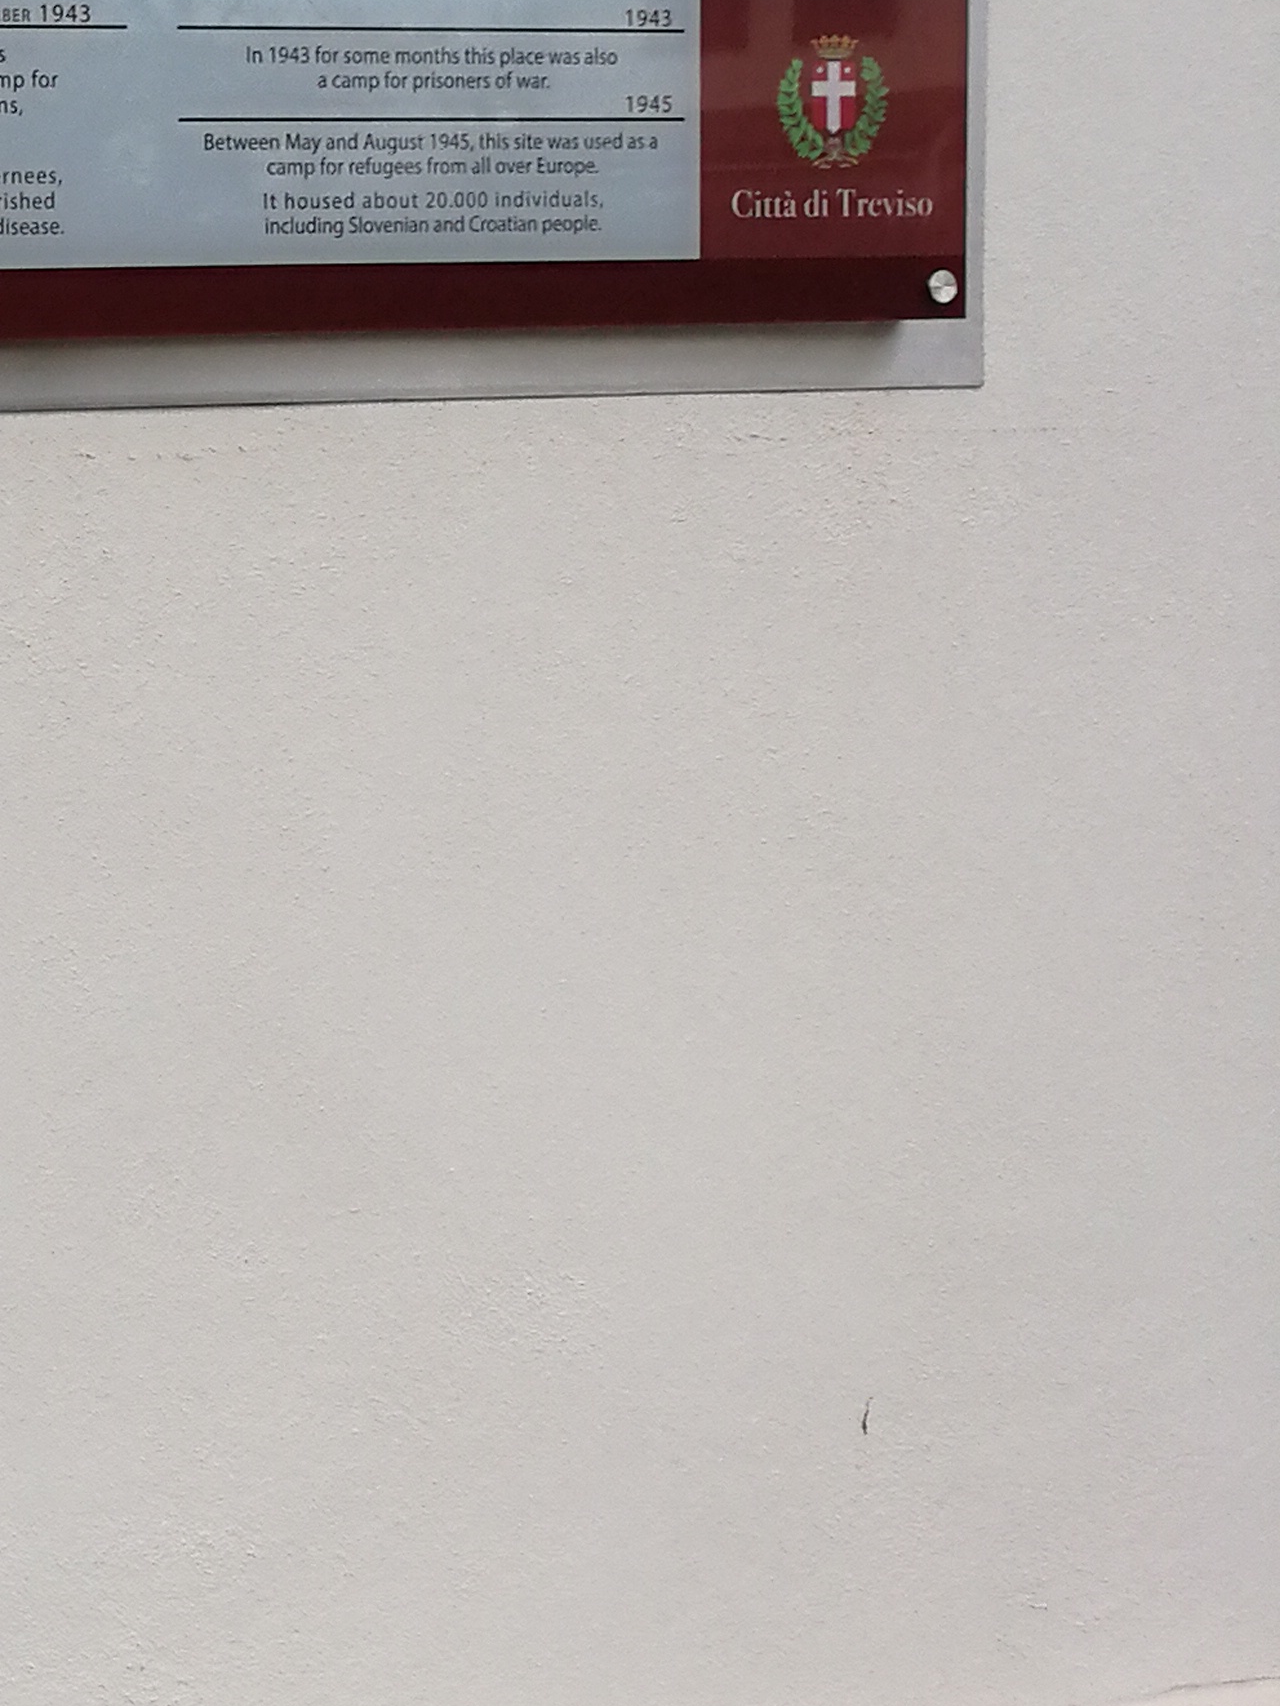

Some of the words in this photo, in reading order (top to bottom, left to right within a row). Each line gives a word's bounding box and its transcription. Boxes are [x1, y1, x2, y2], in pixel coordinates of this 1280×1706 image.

[40, 3, 91, 23] 1943
[625, 8, 672, 28] 1943
[31, 68, 59, 89] for
[625, 94, 673, 114] 1945
[263, 192, 277, 211] It
[284, 191, 355, 211] housed
[361, 191, 419, 210] about
[425, 190, 488, 210] 20.000
[495, 190, 604, 209] individuals,
[731, 189, 797, 218] Città
[803, 188, 829, 218] di
[835, 188, 933, 218] Treviso
